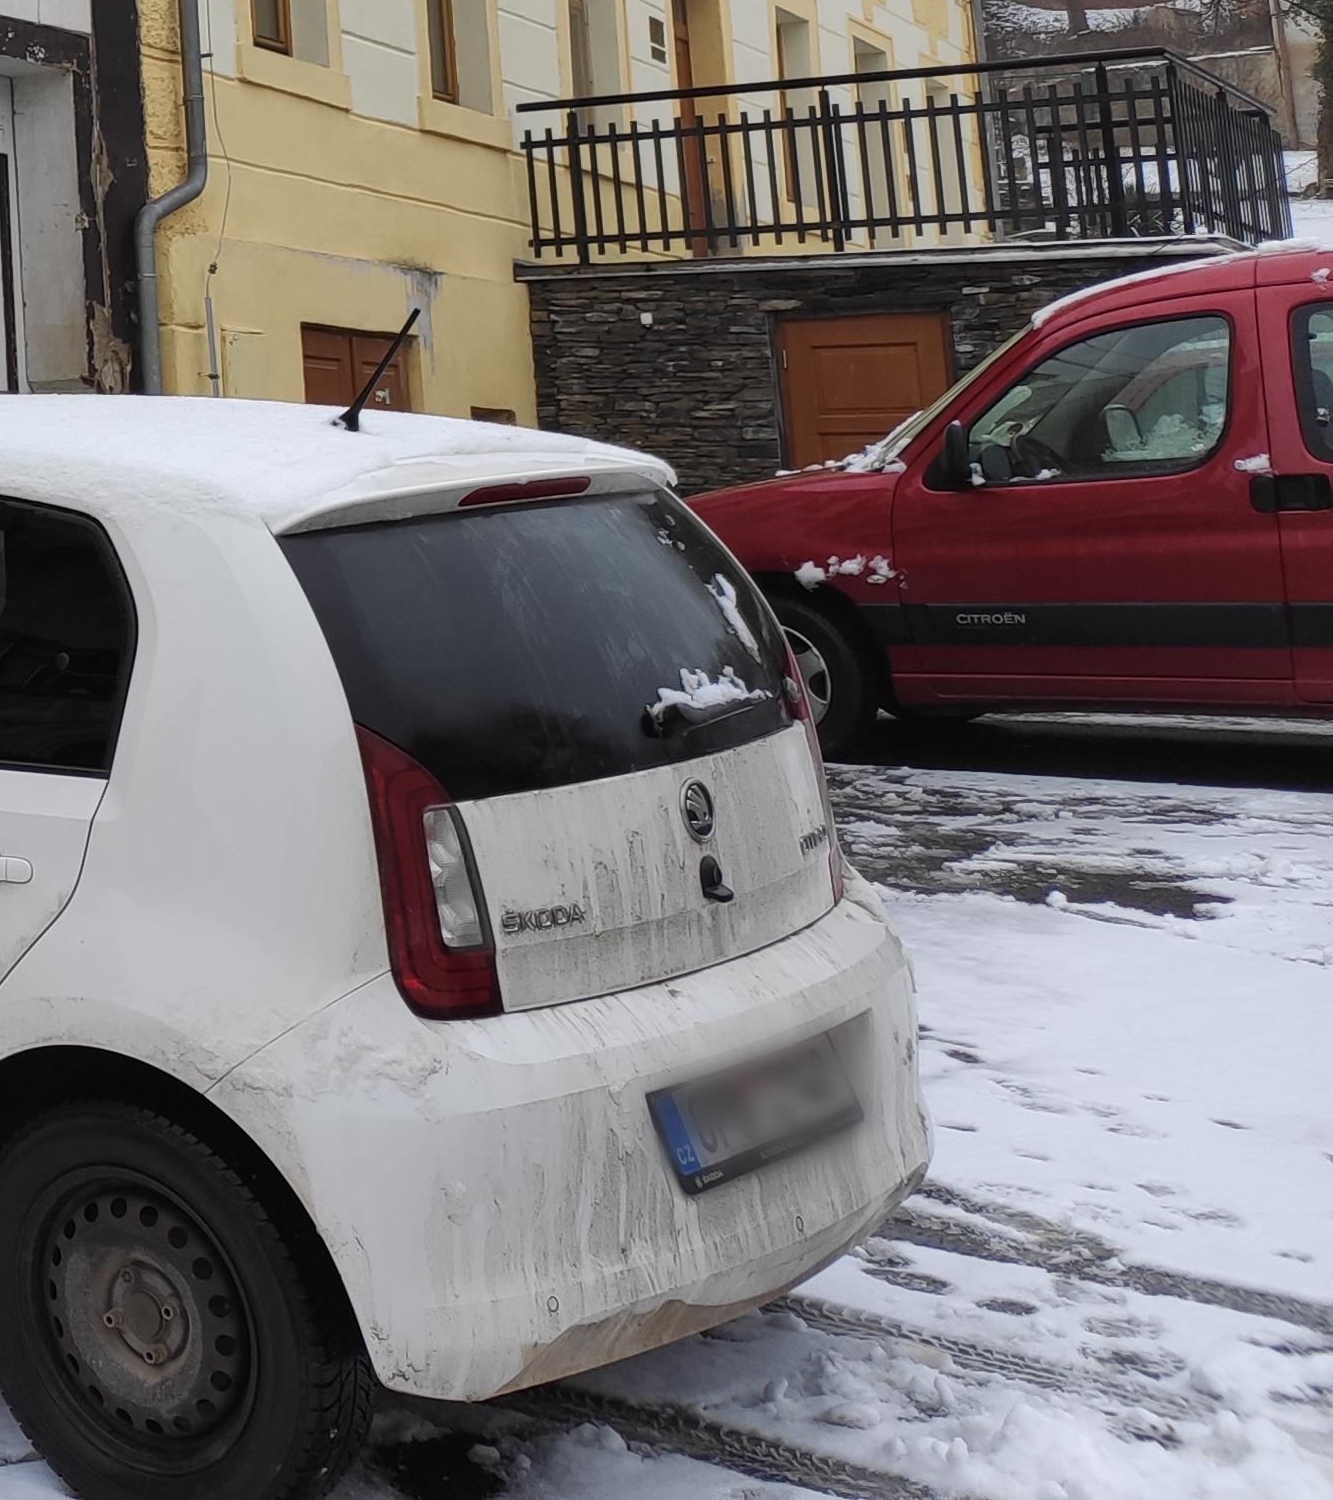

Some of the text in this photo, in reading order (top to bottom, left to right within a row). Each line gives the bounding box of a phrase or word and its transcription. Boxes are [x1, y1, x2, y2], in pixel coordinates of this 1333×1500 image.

[956, 611, 1027, 625] CITROËN
[501, 903, 586, 936] ŠKODA
[676, 1144, 695, 1166] CZ
